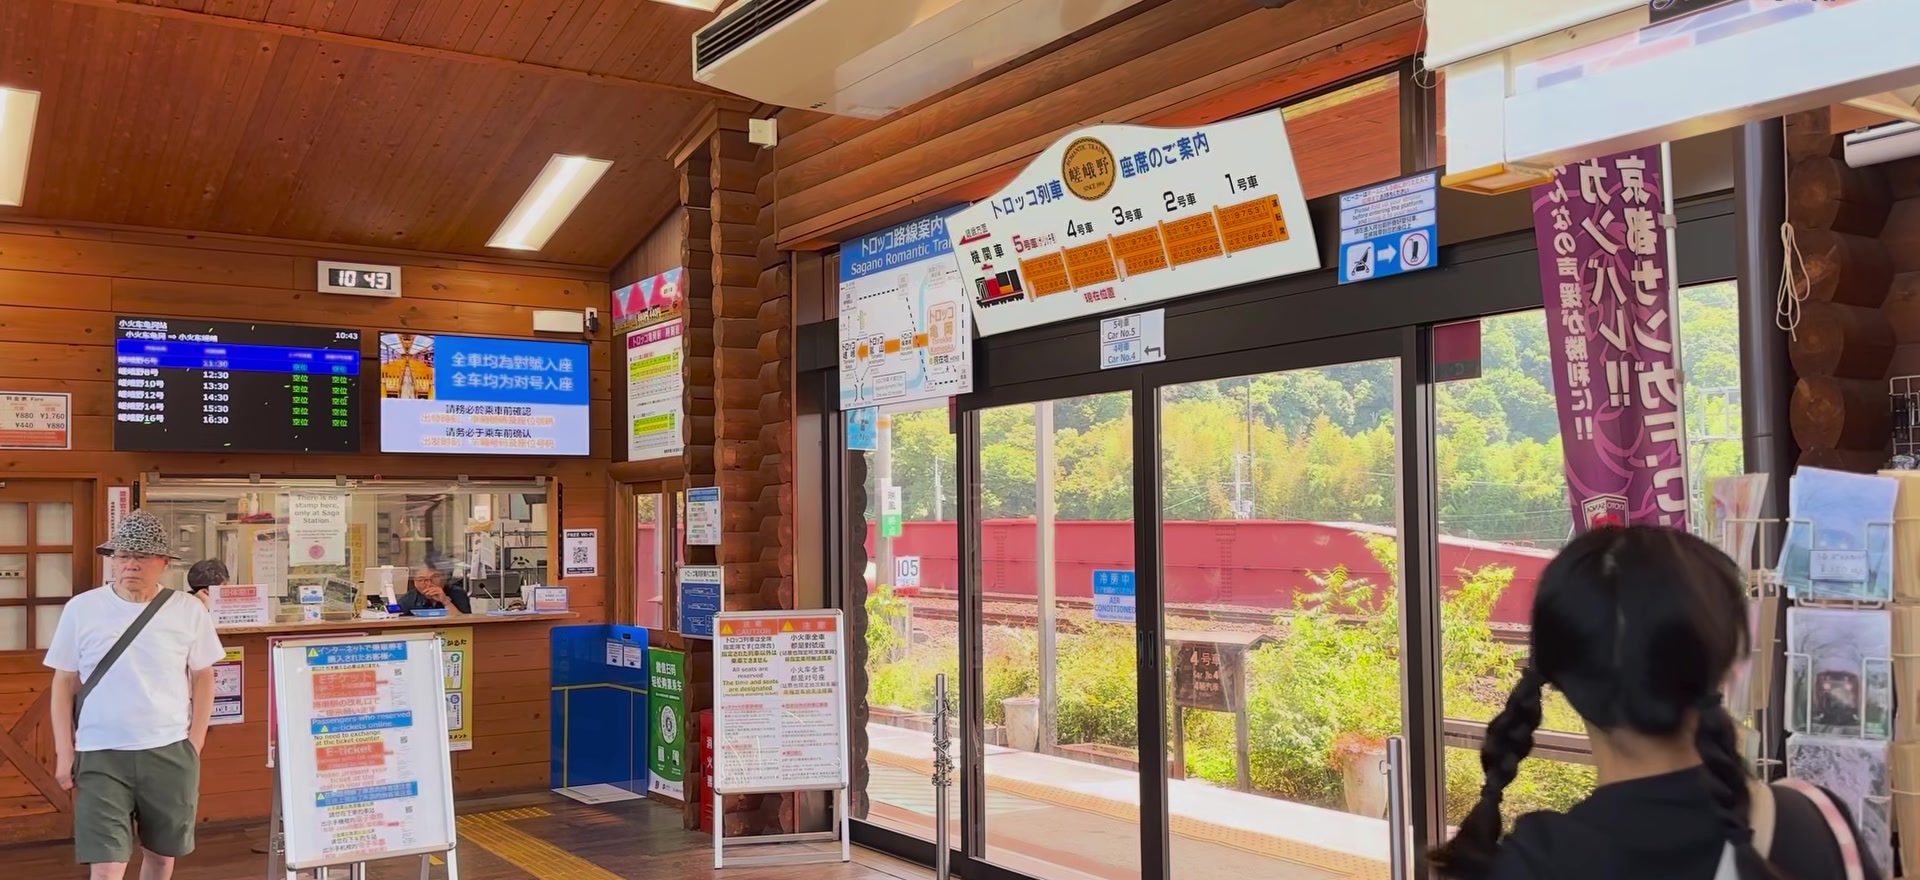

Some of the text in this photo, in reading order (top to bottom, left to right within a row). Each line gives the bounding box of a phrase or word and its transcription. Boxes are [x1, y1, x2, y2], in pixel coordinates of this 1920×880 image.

[991, 131, 1210, 220] トロッコ列車 座席のご案内
[1069, 157, 1109, 183] 嵯峨野
[1225, 174, 1259, 195] 1号車
[1162, 190, 1197, 212] 2号車
[1354, 206, 1370, 214] Please
[1112, 206, 1144, 226] 3号車
[1352, 212, 1368, 221] before
[1369, 208, 1390, 217] entering
[1401, 200, 1423, 210] platform
[861, 214, 944, 258] トロッコ路線案内
[1067, 219, 1094, 238] 4号車
[851, 238, 953, 276] Sagano Romantic Trai
[970, 244, 1004, 264] 機関車
[338, 270, 388, 289] 10 43
[1084, 287, 1116, 303] 現在位置
[930, 306, 954, 323] トロッコ
[1113, 317, 1129, 329] 5号車
[335, 332, 358, 340] 10:43
[1108, 328, 1135, 340] Car No.5
[451, 352, 573, 373] 全車均為對號入座
[1108, 352, 1136, 364] Car No.4
[203, 382, 229, 390] 13:30
[452, 372, 574, 392] 全车均为对号入座
[898, 560, 918, 577] 105
[1100, 573, 1130, 585] 冷房中
[312, 716, 357, 724] Passengers
[332, 722, 366, 732] e-tickets
[326, 744, 372, 756] E-ticket
